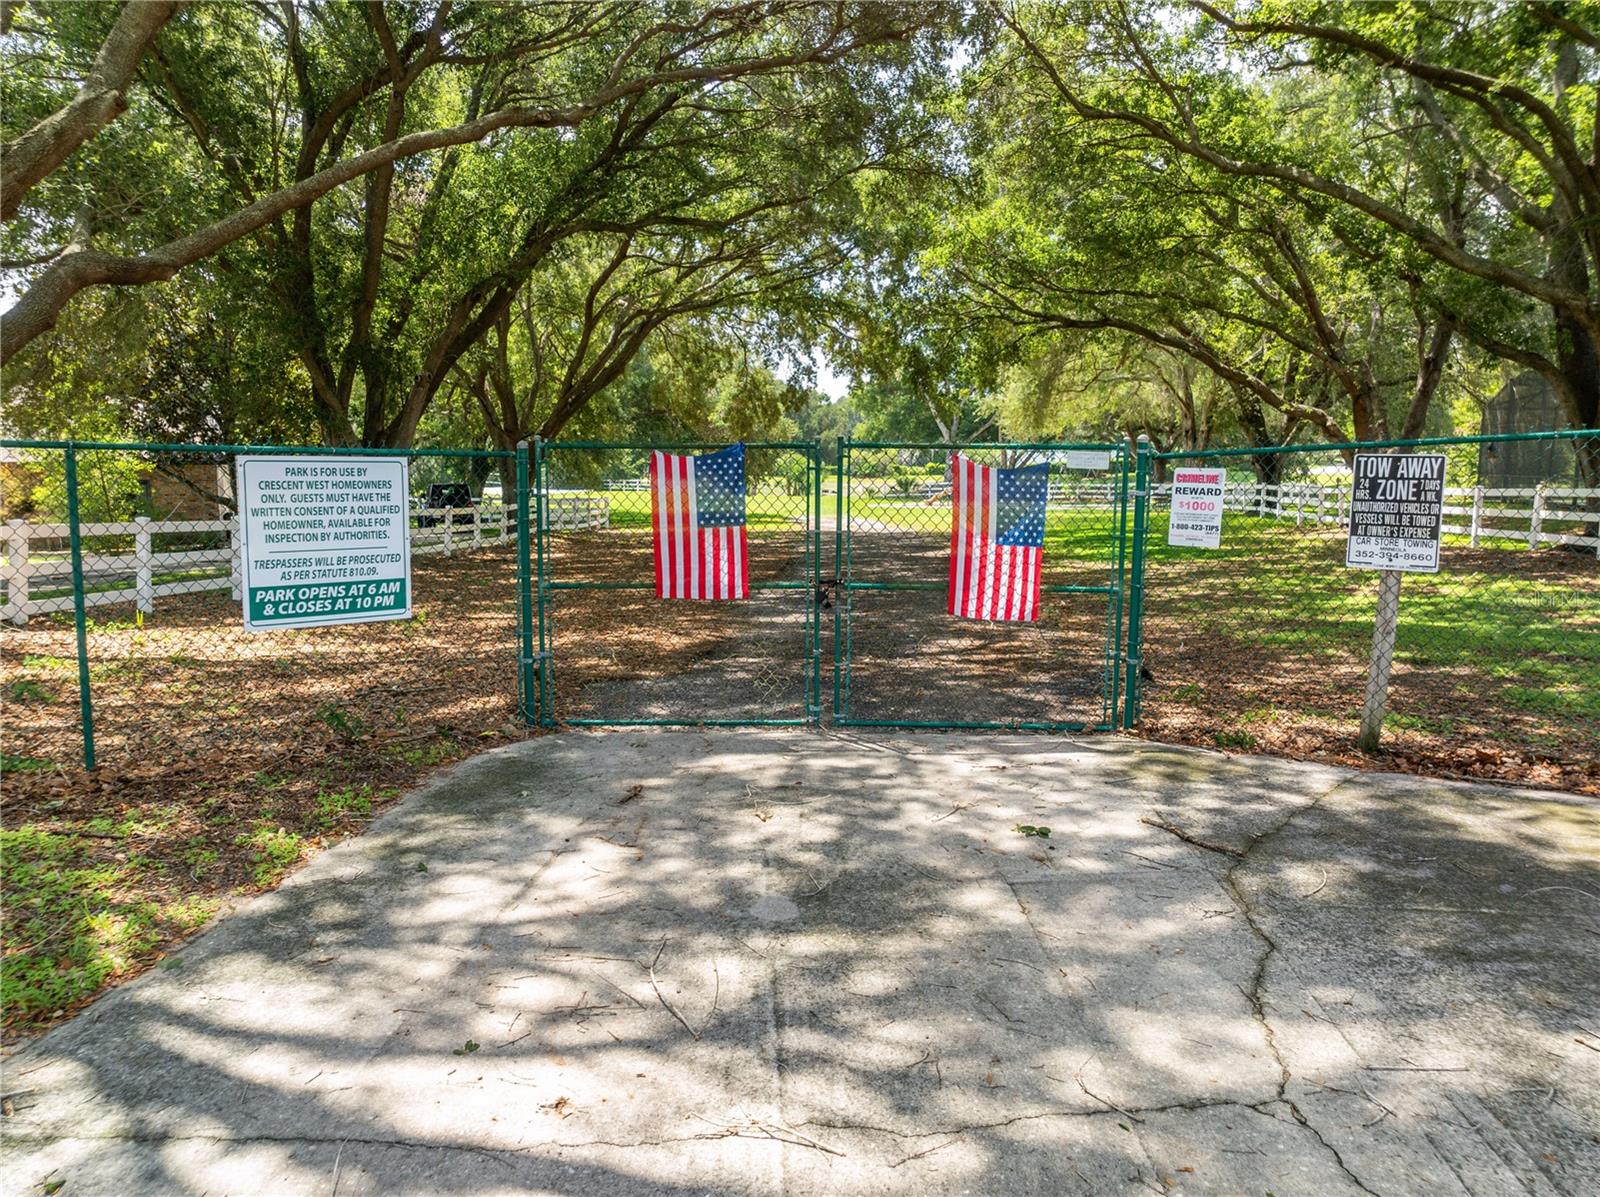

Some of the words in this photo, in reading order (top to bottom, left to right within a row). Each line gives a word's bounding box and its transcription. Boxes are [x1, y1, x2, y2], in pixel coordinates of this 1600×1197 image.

[285, 468, 308, 476] PARK
[311, 467, 318, 476] IS
[320, 467, 337, 476] FOR
[339, 467, 355, 476] USE
[357, 467, 367, 476] BY
[1359, 457, 1392, 478] TOW
[1397, 458, 1443, 478] AWAY
[259, 480, 305, 490] CRESCENT
[306, 480, 329, 490] WEST
[332, 480, 392, 489] HOMEOWNERS
[1360, 479, 1369, 488] 24
[1420, 480, 1424, 490] 7
[1425, 480, 1440, 490] DAYS
[1175, 487, 1221, 496] REWARD
[1356, 490, 1371, 499] HRS.
[1376, 480, 1417, 500] ZONE
[1421, 492, 1425, 501] A
[1426, 491, 1437, 501] WK.
[261, 494, 286, 504] ONLY.
[290, 494, 323, 503] GUESTS
[326, 493, 350, 502] MUST
[352, 493, 374, 502] HAVE
[375, 493, 390, 501] THE
[251, 507, 291, 517] WRITTEN
[294, 506, 334, 516] CONSENT
[337, 506, 349, 515] OF
[350, 506, 356, 515] A
[358, 505, 400, 515] QUALIFIED
[1179, 501, 1215, 511] $1000
[1353, 501, 1398, 512] UNAUTHORIZED
[1400, 503, 1429, 513] VEHICLES
[1431, 504, 1440, 514] OR
[264, 520, 326, 530] HOMEOWNER,
[328, 518, 373, 528] AVAILABLE
[375, 518, 390, 526] FOR
[1355, 513, 1383, 524] VESSELS
[1384, 514, 1400, 525] WILL
[1402, 515, 1411, 526] BE
[1413, 516, 1436, 527] TOWED
[265, 533, 318, 543] INSPECTION
[320, 532, 331, 541] BY
[333, 531, 389, 541] AUTHORITIES.
[1357, 525, 1365, 535] AT
[1367, 526, 1398, 537] OWNER'S
[1400, 527, 1431, 538] EXPENSE
[1356, 537, 1371, 545] CAR
[1374, 538, 1399, 546] STORE
[1404, 540, 1433, 548] TOWING
[254, 558, 312, 570] TRESPASSERS
[315, 557, 334, 566] WILL
[336, 556, 347, 565] BE
[349, 554, 401, 564] PROSECUTED
[1356, 551, 1432, 561] 352-394-8660
[280, 571, 291, 581] AS
[294, 570, 310, 580] PER
[312, 568, 348, 579] STATUTE
[350, 567, 378, 577] 810.09.
[256, 589, 296, 602] PARK
[299, 586, 346, 599] OPENS
[349, 584, 366, 595] AT
[368, 583, 376, 594] 6
[379, 582, 400, 594] AM
[263, 604, 275, 616] &
[278, 600, 332, 615] CLOSES
[335, 599, 352, 610] AT
[356, 597, 370, 609] 10
[374, 595, 394, 607] PM
